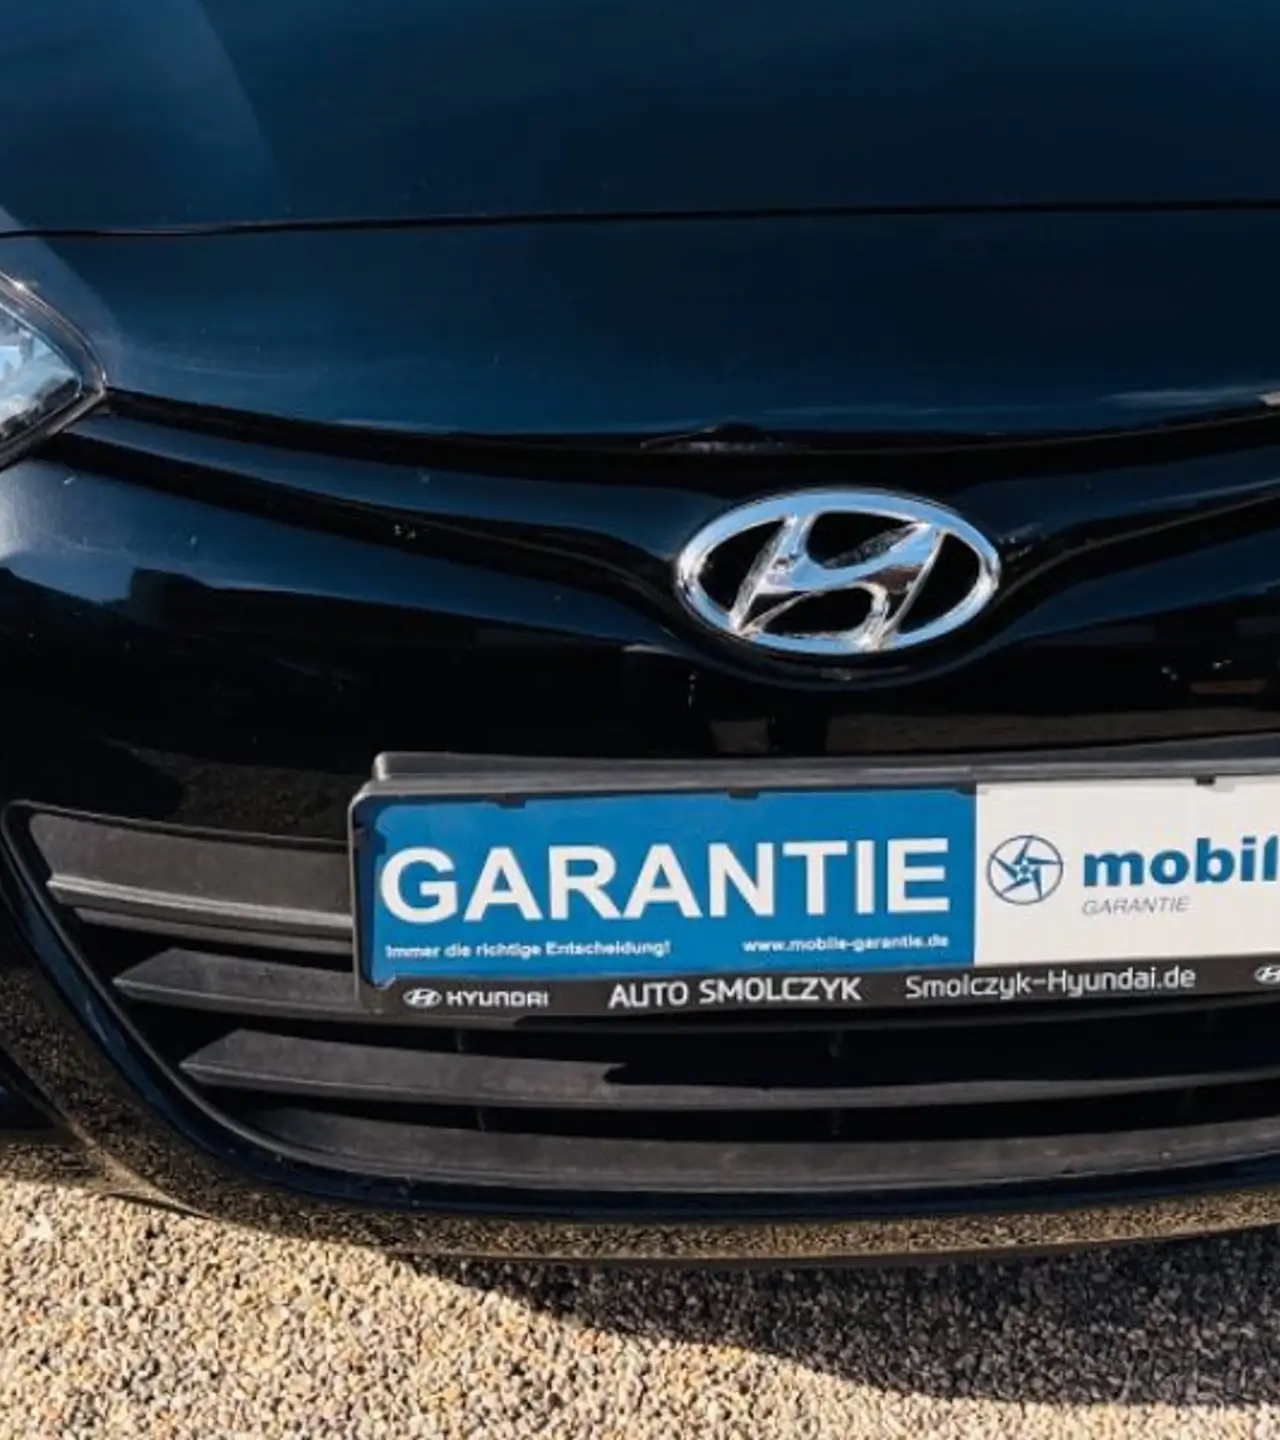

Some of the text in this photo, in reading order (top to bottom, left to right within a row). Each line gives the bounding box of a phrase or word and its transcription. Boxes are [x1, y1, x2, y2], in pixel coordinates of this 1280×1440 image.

[379, 836, 951, 923] GARANTIE
[1080, 895, 1191, 916] GARANTIE
[385, 938, 671, 960] Immer die richtige Entscheidung!
[742, 932, 950, 954] www.mobile-garantie.de
[446, 966, 1196, 1010] HYUNDAI AUTO SMOLCZYK Smolczyk-Hyundai.de
